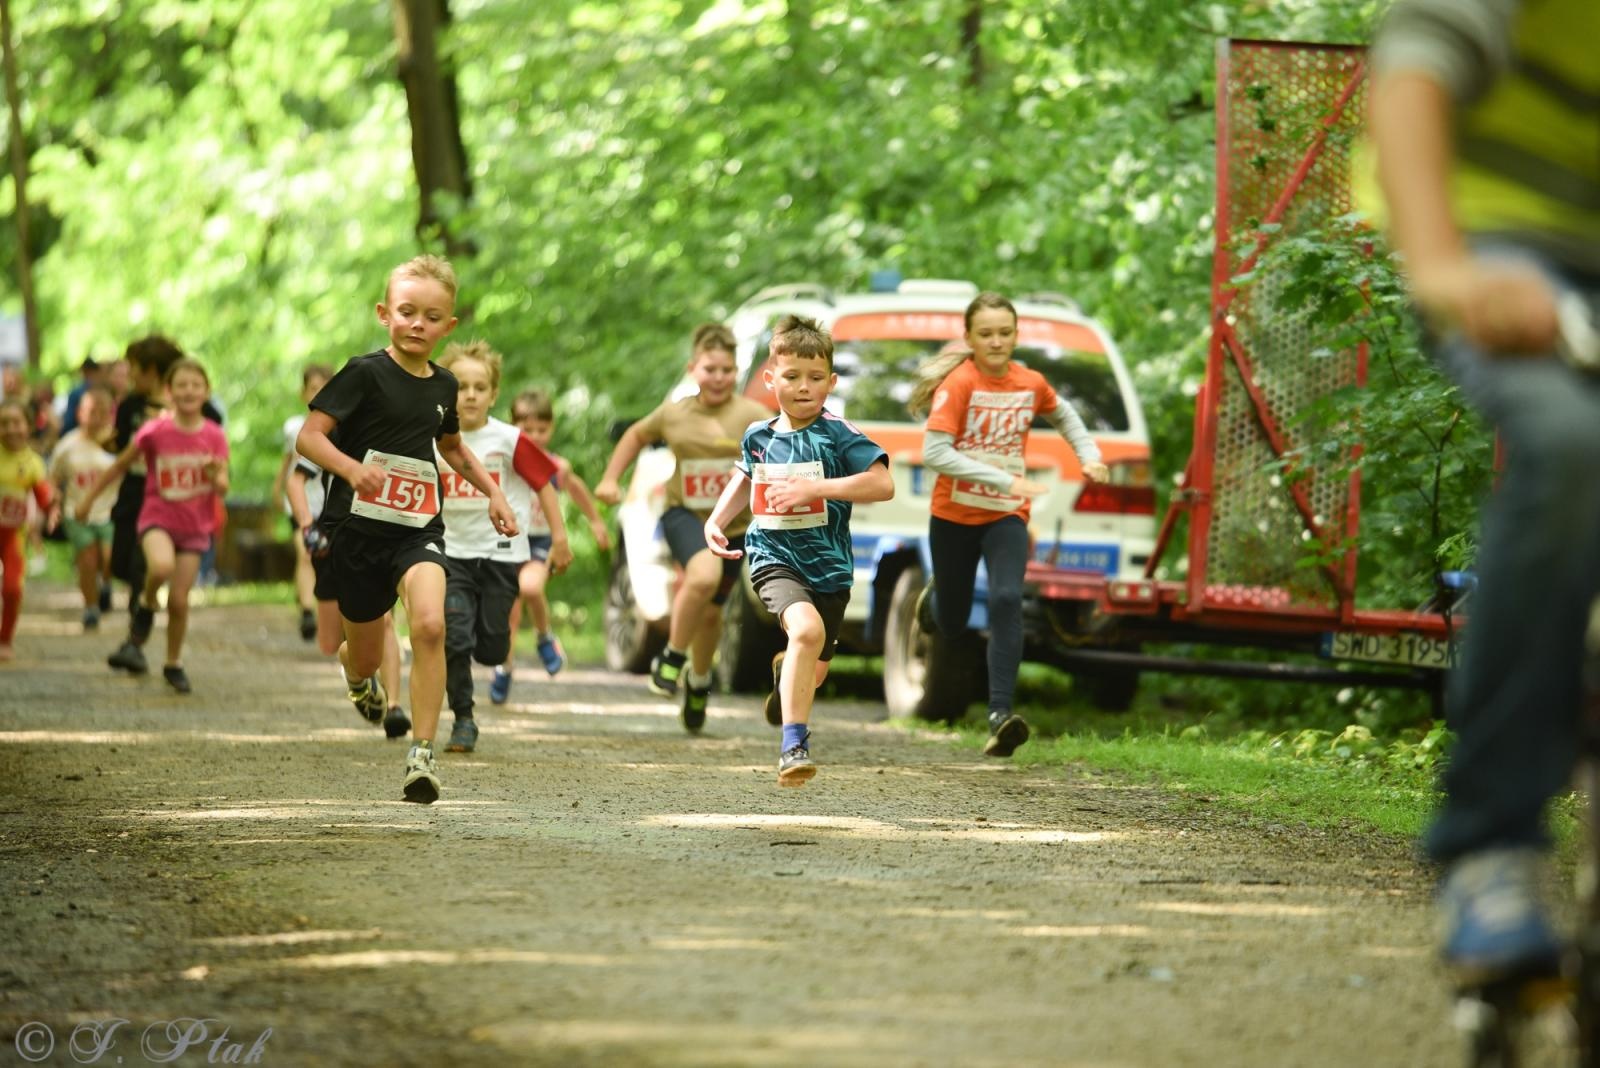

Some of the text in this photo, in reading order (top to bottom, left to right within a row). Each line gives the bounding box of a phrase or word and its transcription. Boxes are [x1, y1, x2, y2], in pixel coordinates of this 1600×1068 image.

[375, 477, 426, 511] 159
[447, 474, 488, 497] 14
[1334, 630, 1380, 657] SWD
